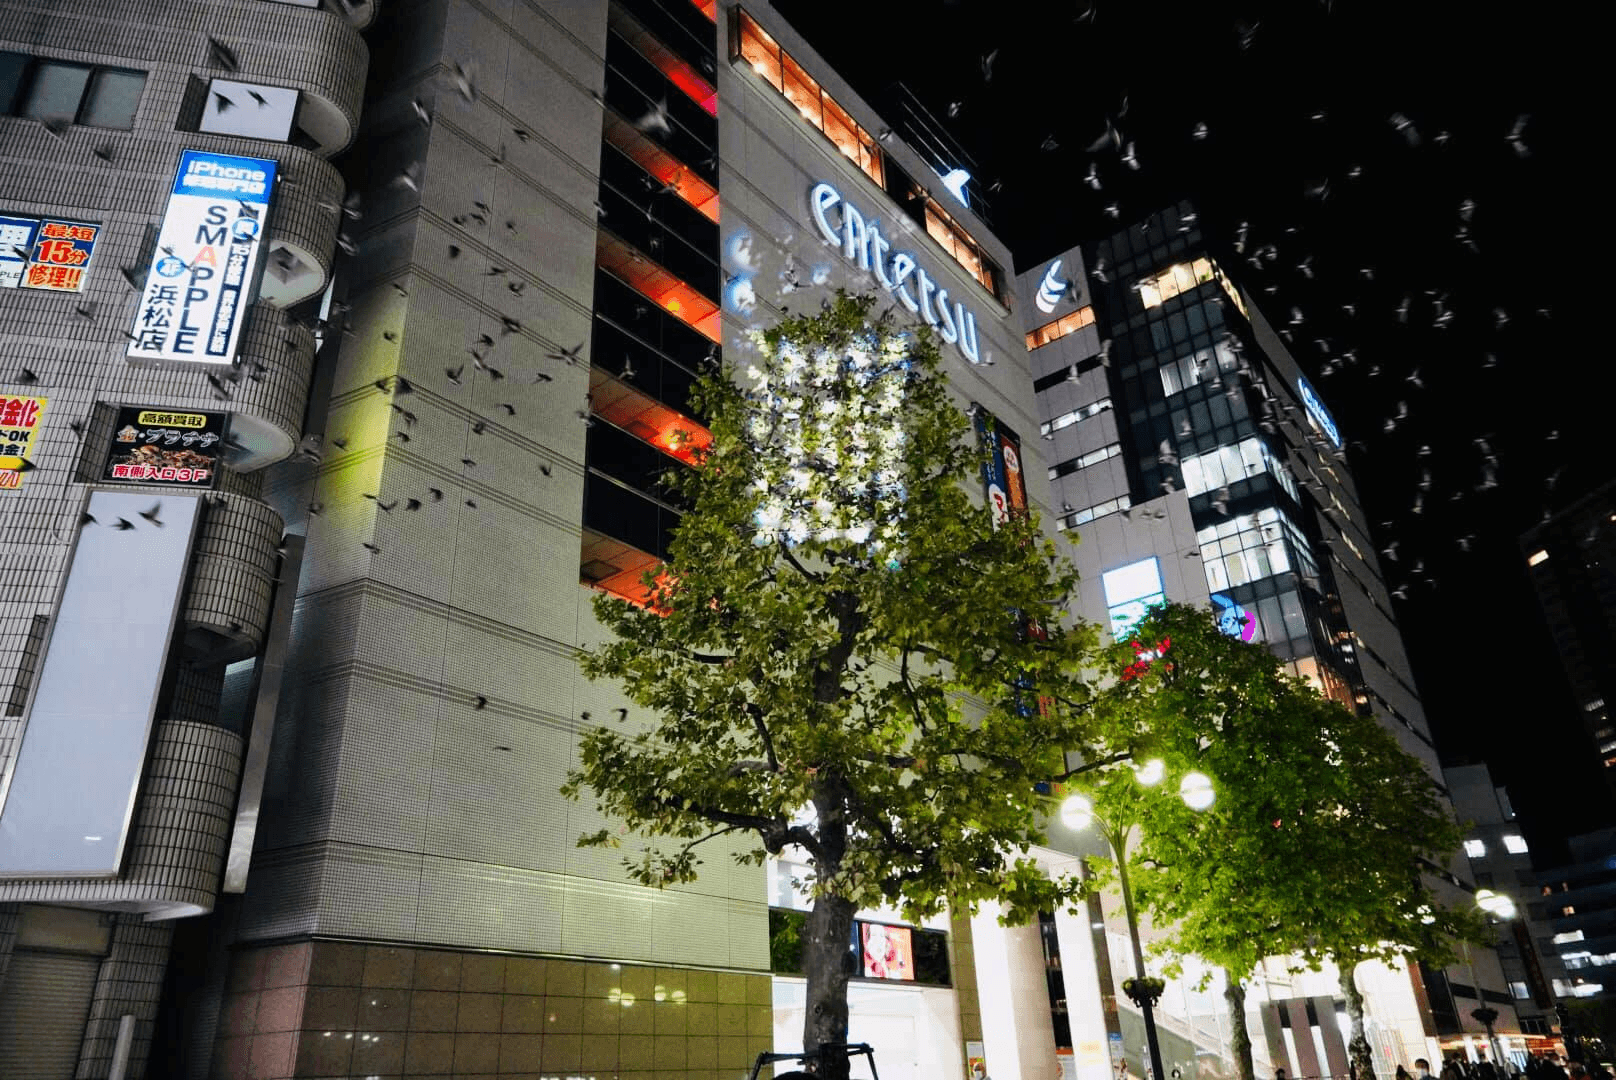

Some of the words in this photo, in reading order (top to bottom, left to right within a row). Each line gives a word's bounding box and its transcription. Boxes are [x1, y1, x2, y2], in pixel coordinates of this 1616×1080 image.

[42, 222, 97, 242] 最短
[38, 239, 89, 266] 15分
[26, 263, 82, 289] 修理!!
[173, 204, 228, 354] SMAPPLE
[134, 283, 179, 354] 浜松店
[142, 413, 203, 427] 高額買取
[112, 463, 208, 482] 南側入口3F
